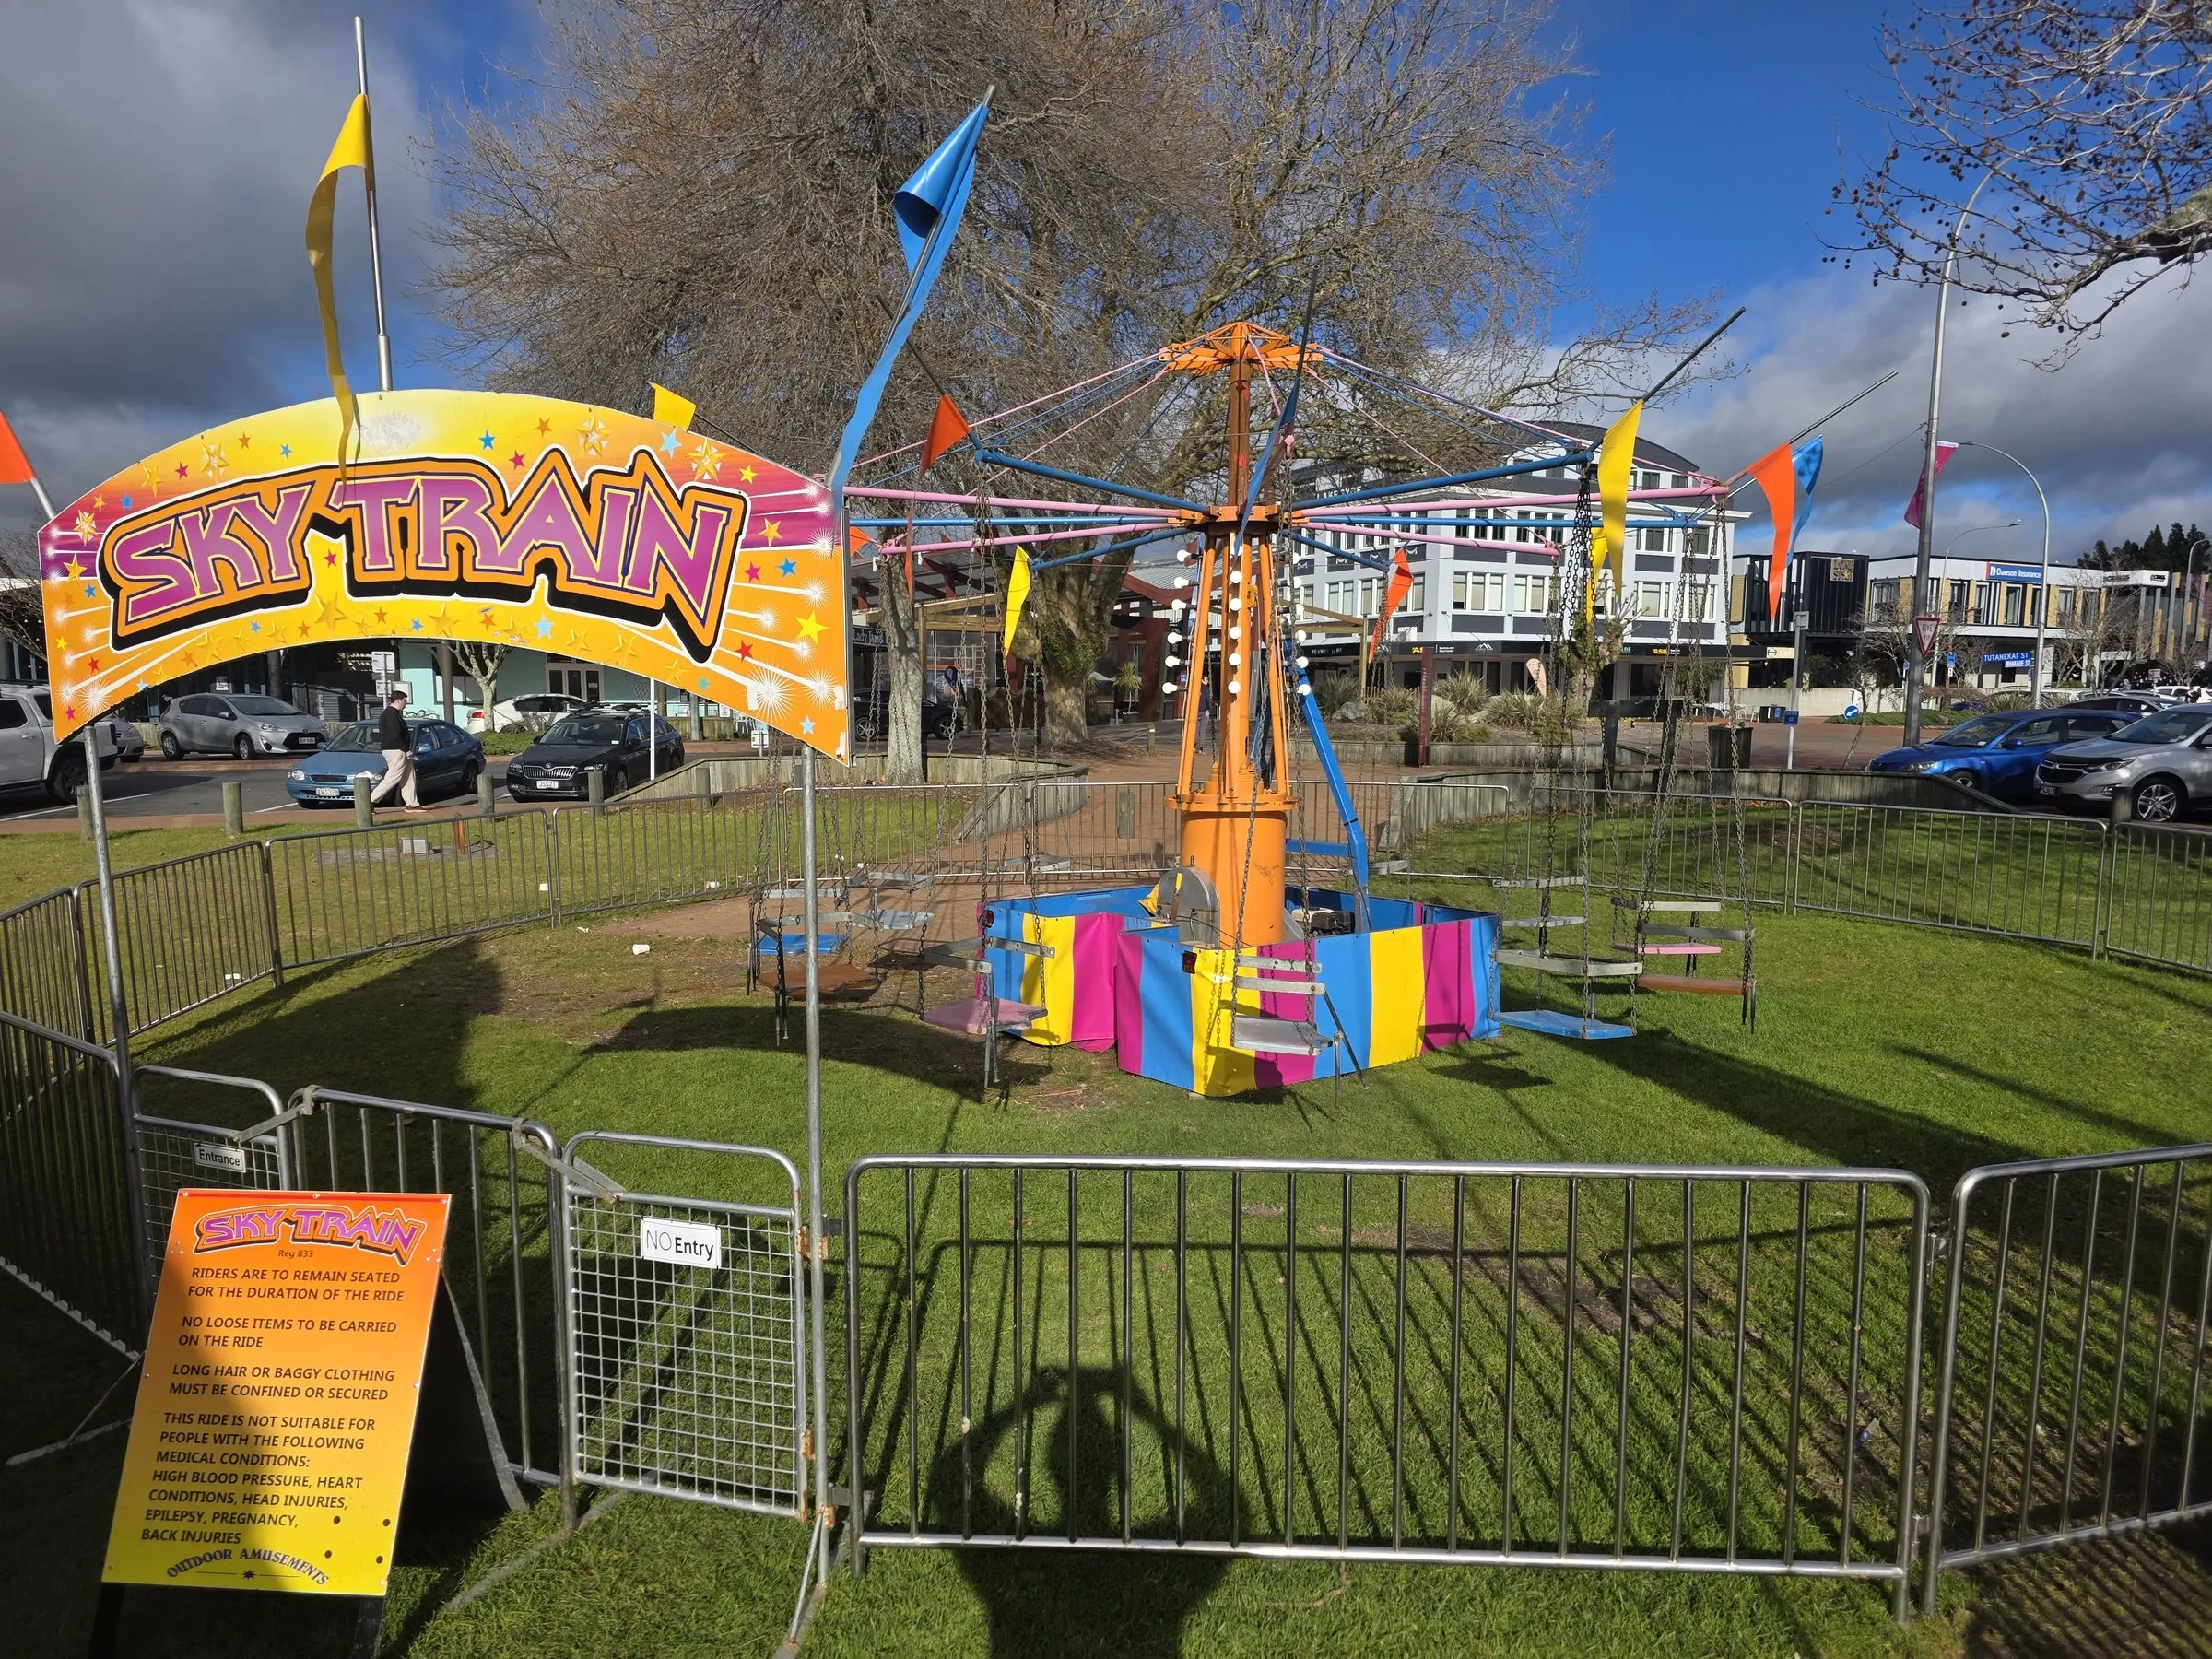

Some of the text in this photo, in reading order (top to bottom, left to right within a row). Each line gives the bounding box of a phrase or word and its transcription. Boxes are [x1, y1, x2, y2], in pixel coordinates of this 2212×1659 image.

[112, 466, 733, 628] SKY TRAIN
[1996, 568, 2041, 579] Dawson Insurance
[853, 628, 868, 643] Lady
[1983, 653, 2018, 662] TUTANEKAI
[199, 1148, 241, 1167] Entrance
[203, 1209, 419, 1254] SKY TRAIN
[646, 1229, 714, 1262] NO Entry
[278, 1250, 293, 1259] Reg
[192, 1268, 400, 1283] RIDERS ARE TO REMAIN SEATED
[188, 1286, 404, 1301] FOR THE DURATION OF THE RIDE
[182, 1316, 396, 1333] NO LOOSE ITEMS TO BE CARRIED
[179, 1335, 264, 1347] ON THE RIDE
[172, 1364, 394, 1382] LONG HAIR OR BAGGY CLOTHING
[170, 1382, 389, 1400] MUST BE CONFINED OR SECURED
[164, 1413, 375, 1430] THIS RIDE IS NOT SUITABLE FOR
[159, 1431, 364, 1450] PEOPLE WITH THE FOLLOWING
[157, 1451, 310, 1466] MEDICAL CONDITIONS:
[152, 1470, 362, 1488] HIGH BLOOD PRESSURE, HEART
[148, 1488, 348, 1510] CONDITIONS, HEAD INJURIES,
[145, 1509, 299, 1528] EPILEPSY, PREGNANCY,
[141, 1529, 241, 1544] BACK INJURIES
[166, 1547, 329, 1585] OUTDOOR AMUSEMENTS
